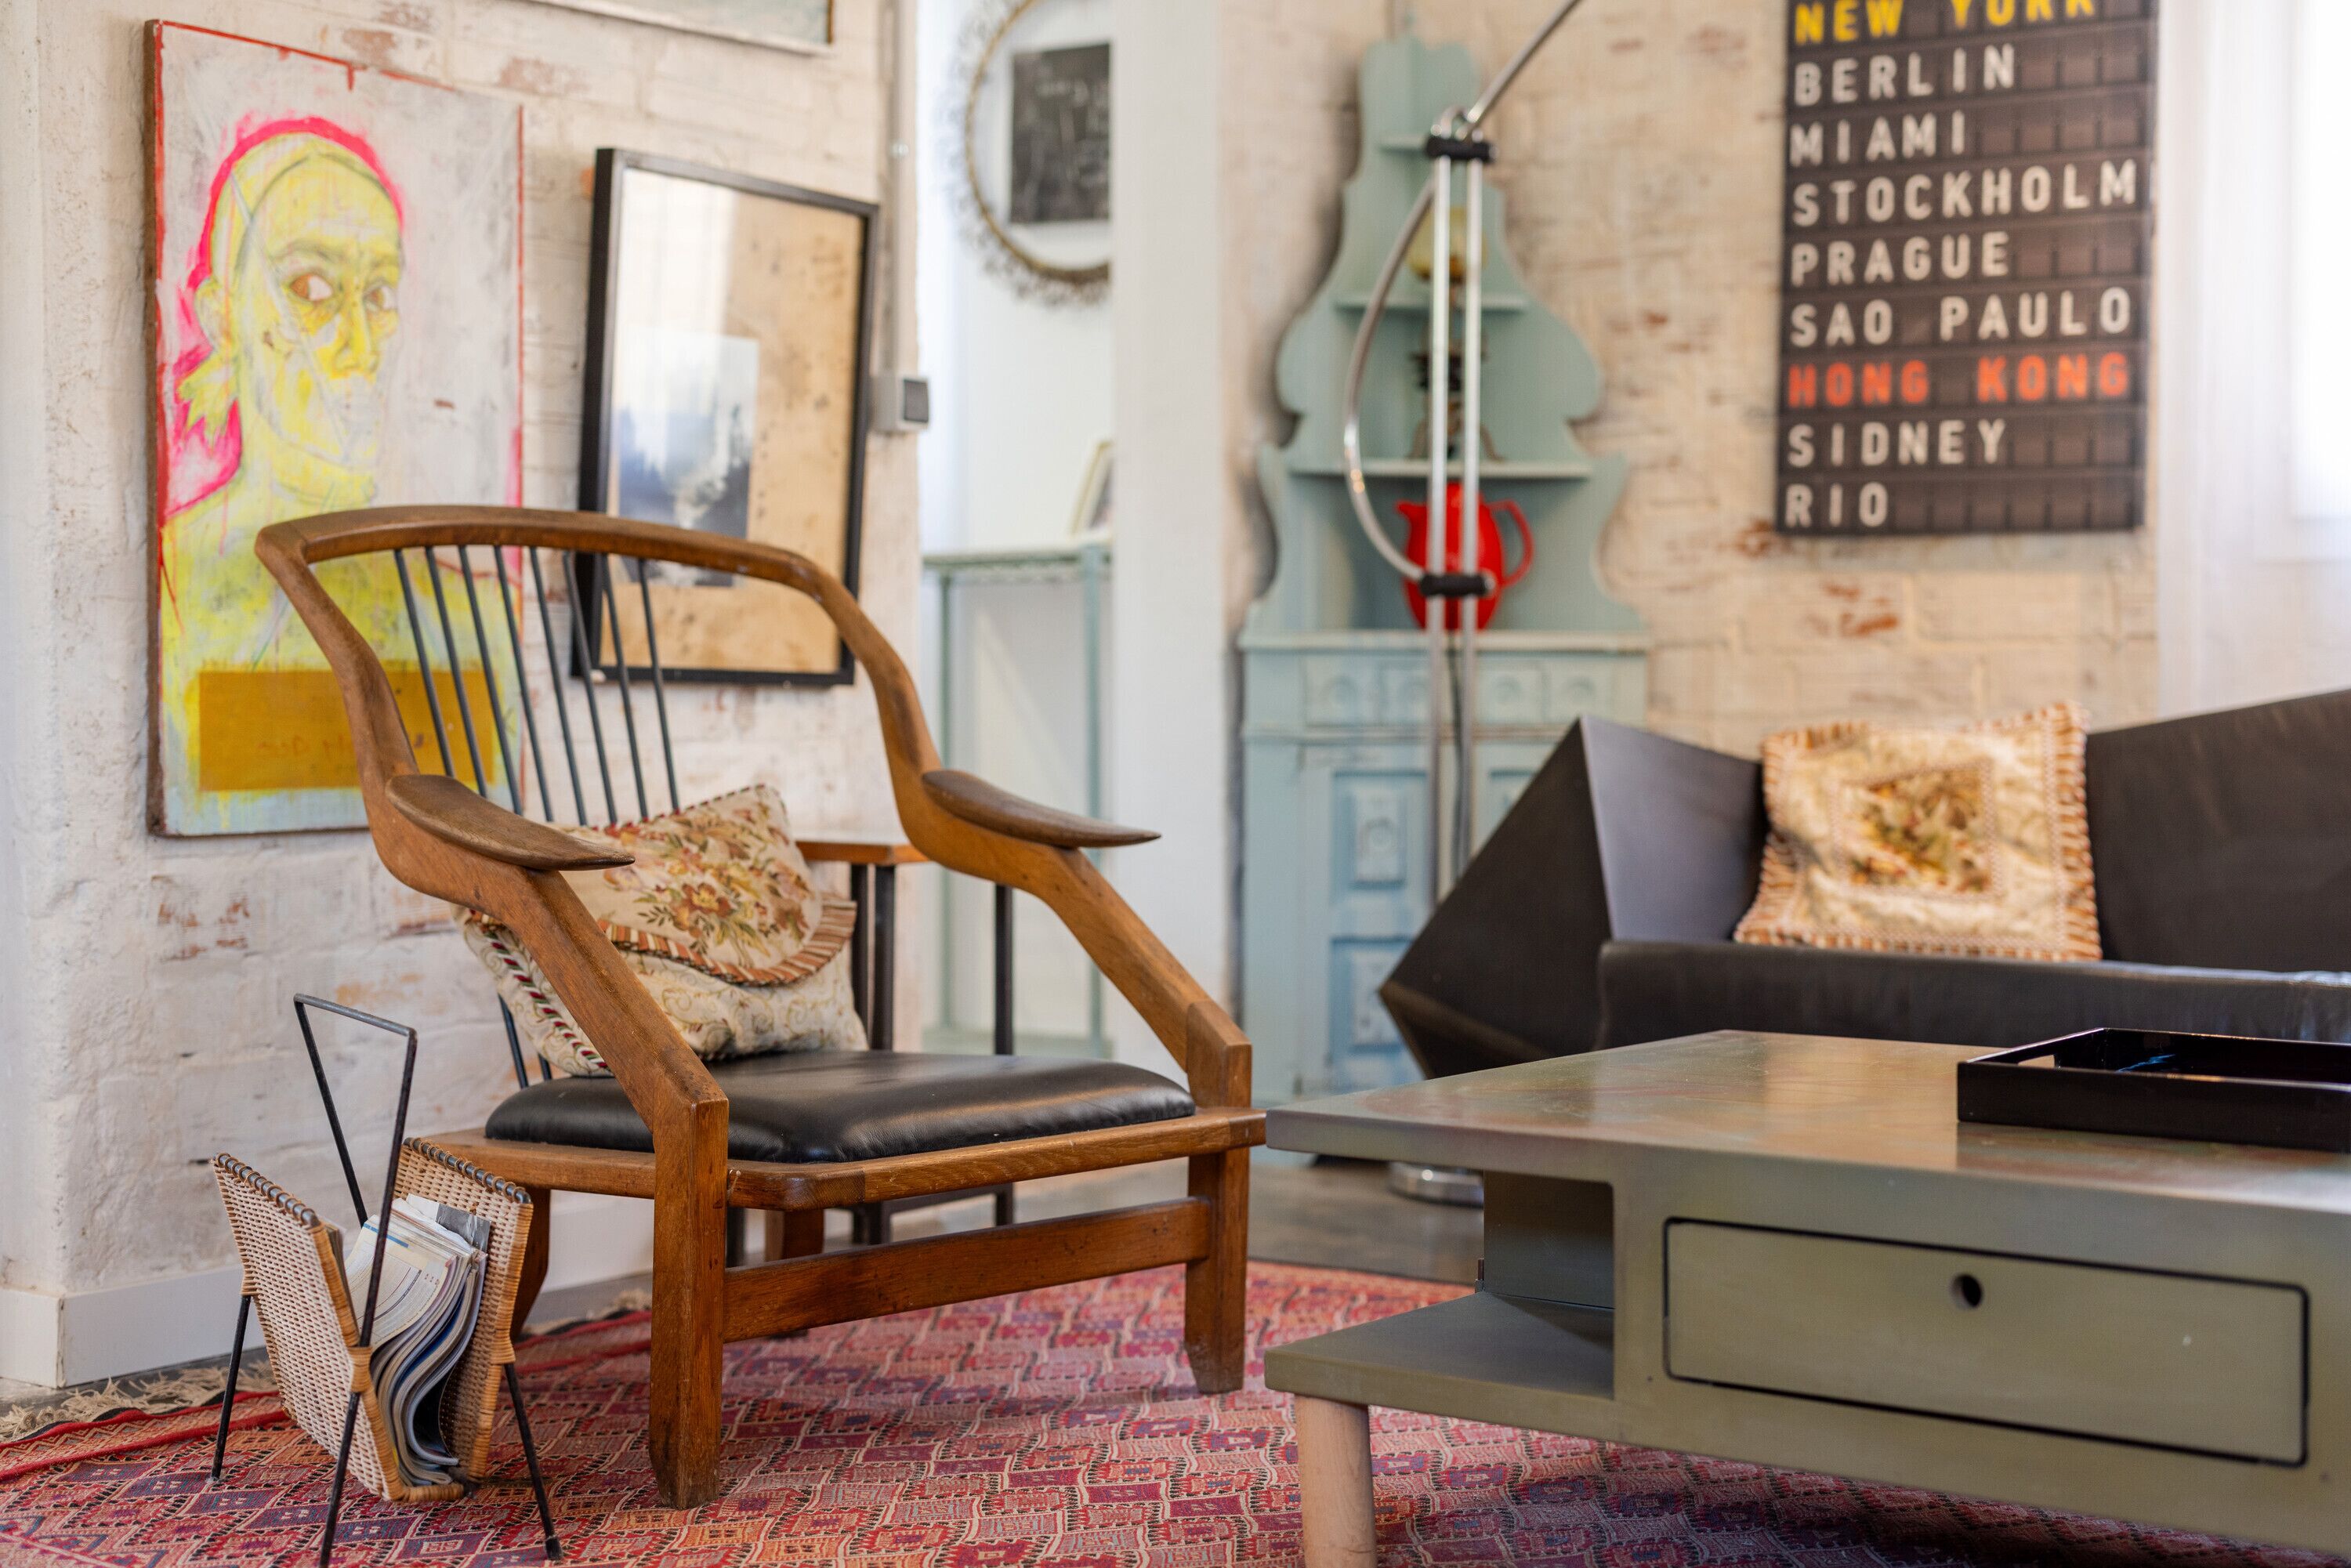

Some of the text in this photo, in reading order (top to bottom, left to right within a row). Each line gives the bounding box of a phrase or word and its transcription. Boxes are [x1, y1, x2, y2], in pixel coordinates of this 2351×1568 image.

[1795, 0, 1904, 45] NEW
[1795, 42, 2015, 107] BERLIN
[1791, 110, 1965, 166] MIAMI
[1792, 158, 2137, 226] STOCKHOLM
[1791, 231, 2010, 284] PRAGUE
[1791, 287, 2130, 346] SAO PAULO
[1788, 352, 2128, 407] HONG KONG
[1788, 418, 2005, 467] SIDNEY
[1785, 482, 1889, 527] RIO
